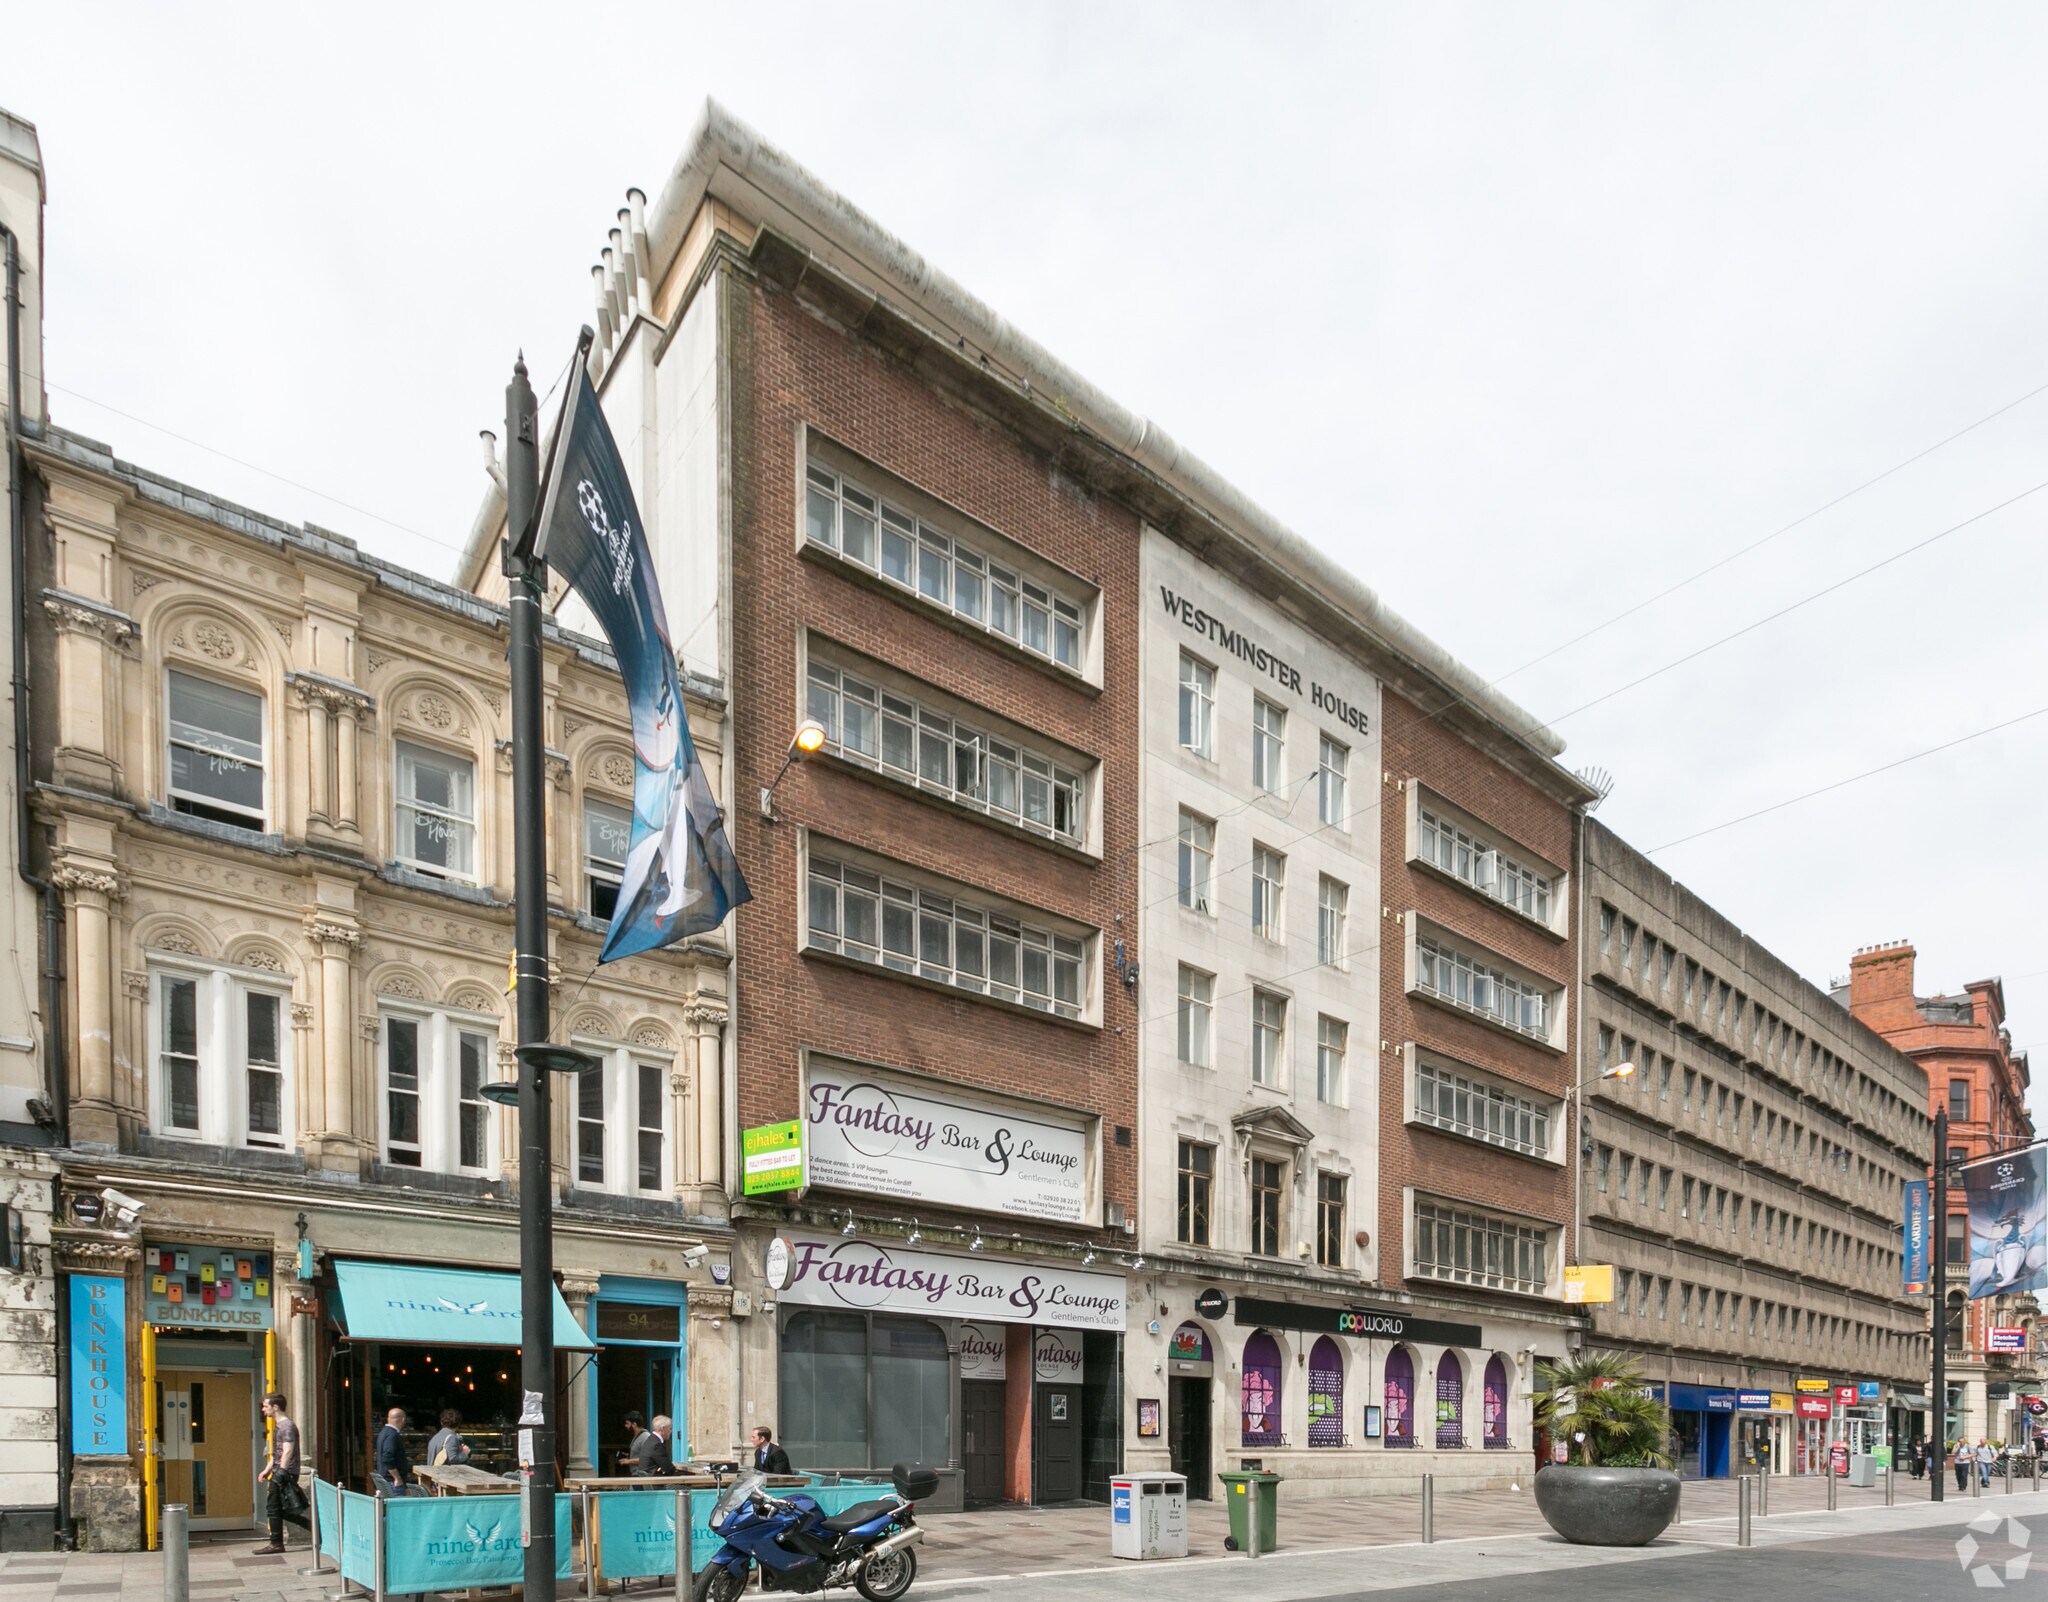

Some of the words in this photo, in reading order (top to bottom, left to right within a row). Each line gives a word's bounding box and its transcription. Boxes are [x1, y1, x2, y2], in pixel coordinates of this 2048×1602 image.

[1160, 585, 1303, 695] WESTMINSTER
[1311, 682, 1369, 736] HOUSE
[809, 1083, 936, 1151] Fantasy
[941, 1123, 981, 1150] Bar
[985, 1128, 1014, 1175] &
[1016, 1139, 1079, 1173] Lounge
[746, 1131, 785, 1152] ejhales
[814, 1157, 832, 1165] dance
[866, 1166, 889, 1174] lounges
[746, 1174, 759, 1184] 029
[761, 1171, 779, 1181] 2037
[780, 1168, 800, 1178] 8844
[833, 1169, 850, 1177] exotic
[851, 1172, 869, 1180] dance
[869, 1175, 886, 1183] venue
[893, 1178, 913, 1187] Cardiff
[1018, 1171, 1062, 1186] Gentlemen's
[1063, 1178, 1079, 1189] Club
[834, 1177, 857, 1186] dancers
[857, 1180, 879, 1191] waiting
[886, 1186, 911, 1195] entertain
[1911, 1188, 1922, 1206] 2017
[1911, 1210, 1921, 1249] CARDIFF
[1911, 1252, 1921, 1280] FINAL
[792, 1241, 952, 1303] Fantasy
[956, 1274, 1006, 1300] Bar
[1008, 1276, 1045, 1318] &
[1045, 1284, 1121, 1316] Lounge
[157, 1306, 262, 1325] BUNKHOUSE
[628, 1313, 649, 1326] 94
[1051, 1310, 1100, 1325] Gentlemen's
[1101, 1314, 1120, 1326] Club
[89, 1284, 108, 1447] BUNKHOUSE
[634, 1526, 674, 1543] nine
[427, 1536, 474, 1555] nine
